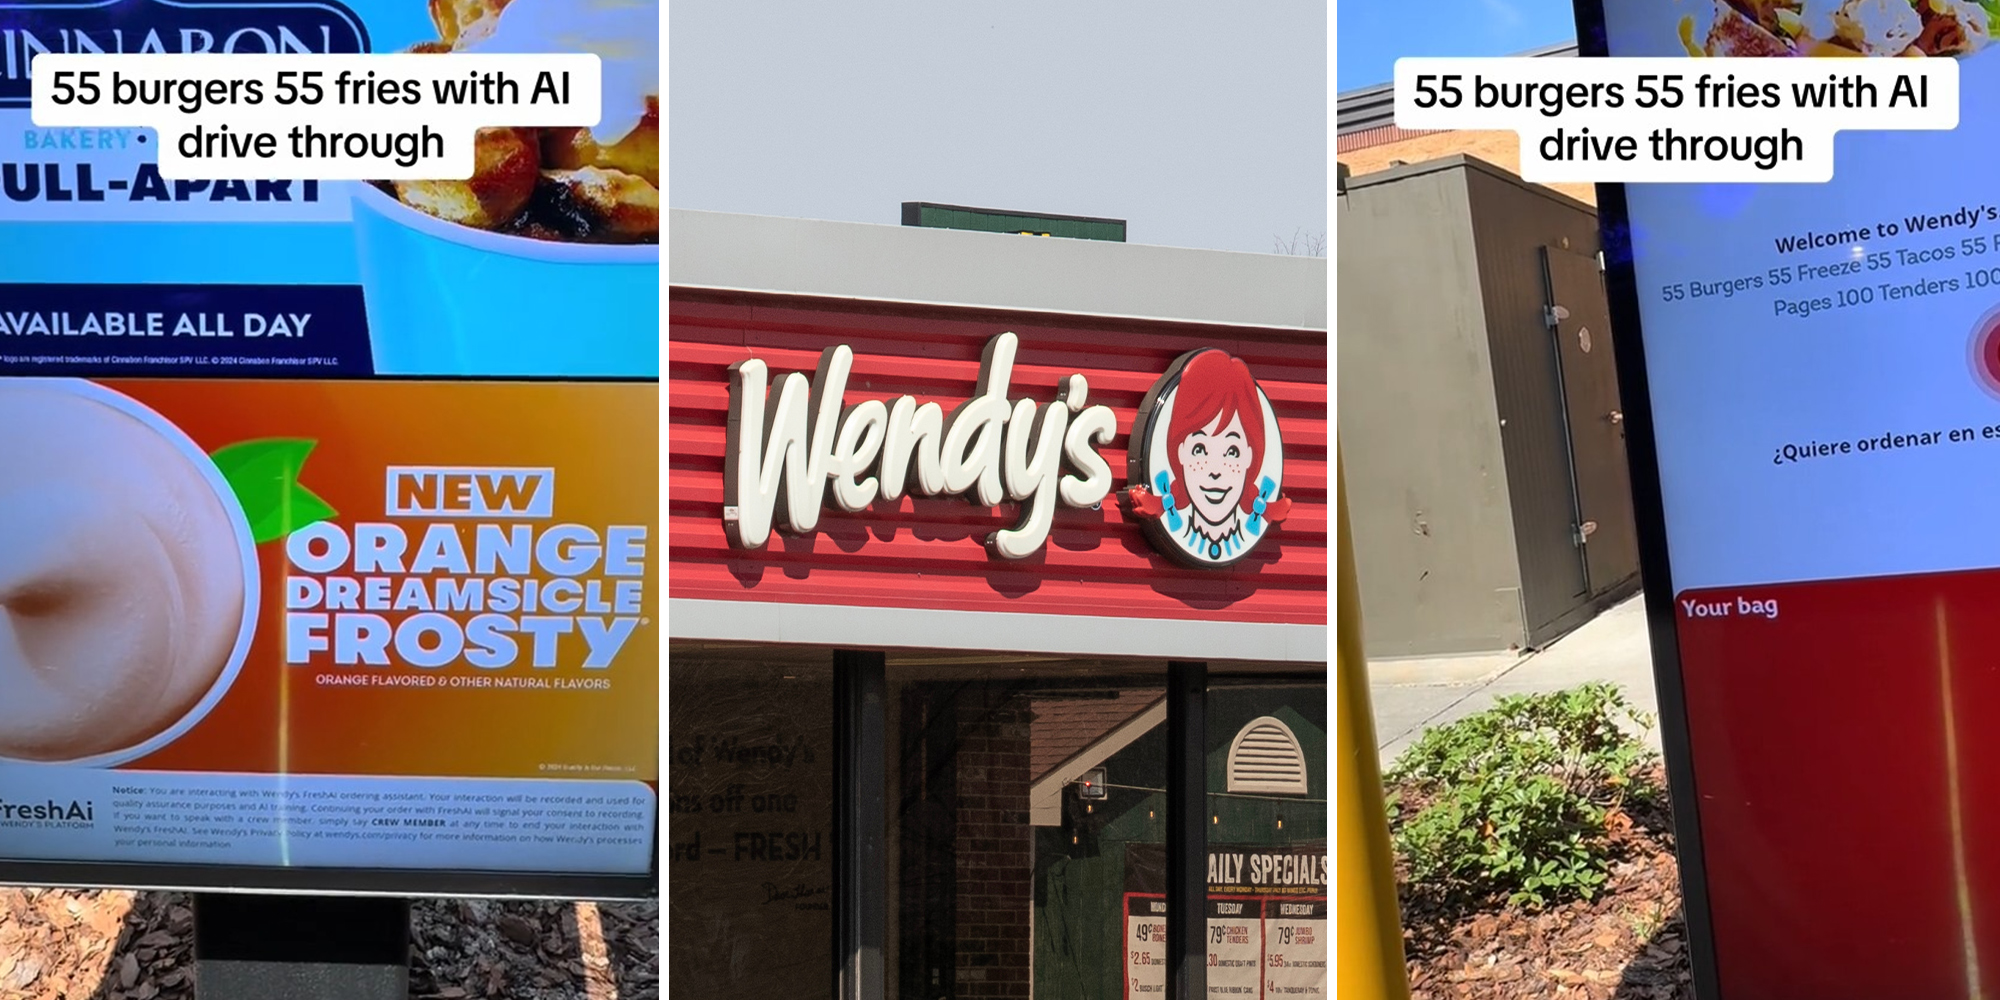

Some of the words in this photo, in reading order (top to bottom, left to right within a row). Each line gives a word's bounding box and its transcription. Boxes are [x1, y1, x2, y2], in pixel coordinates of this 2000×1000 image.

[24, 129, 130, 150] BAKERY
[2, 163, 319, 202] ULL-APART
[1775, 227, 1871, 254] Welcome
[1877, 223, 1899, 239] to
[1904, 204, 2000, 234] Wendy's
[1662, 284, 1685, 302] 55
[1690, 273, 1764, 298] Burgers
[1768, 266, 1793, 286] 55
[1797, 258, 1861, 283] Freeze
[1866, 251, 1891, 271] 55
[1896, 243, 1955, 267] Tacos
[1961, 237, 1987, 257] 55
[1773, 295, 1832, 318] Pages
[1836, 287, 1874, 308] 100
[1878, 276, 1960, 301] Tenders
[1965, 267, 2000, 289] 100
[172, 312, 234, 337] ALL
[244, 313, 312, 337] DAY
[736, 332, 1117, 558] Wendy's
[1773, 440, 1851, 465] ¿Quiere
[1857, 430, 1942, 452] ordenar
[1949, 427, 1974, 442] en
[396, 473, 543, 511] NEW
[286, 522, 648, 576] ORANGE
[286, 577, 644, 614] DREAMSICLE
[1681, 599, 1733, 617] Your
[1737, 596, 1778, 618] bag
[316, 674, 369, 686] ORANGE
[371, 674, 435, 687] FLAVORED
[437, 675, 447, 687] &
[449, 675, 492, 688] OTHER
[495, 676, 552, 689] NATURAL
[554, 677, 611, 690] FLAVORS
[0, 799, 93, 821] reshAi
[751, 792, 798, 814] one
[1, 820, 42, 829] WENDY'S
[44, 821, 94, 830] PLATFORM
[372, 818, 400, 827] CREW
[404, 819, 446, 828] MEMBER
[734, 831, 821, 861] FRESH
[1250, 854, 1327, 885] SPECIALS
[1217, 902, 1243, 915] TUESDAY
[1280, 903, 1314, 915] WEDNESDAY
[1226, 926, 1248, 935] CHICKEN
[1226, 935, 1249, 944] TENDERS
[1295, 927, 1312, 935] JUMBO
[1295, 936, 1315, 945] SHRIMP
[1130, 951, 1150, 965] $2.65
